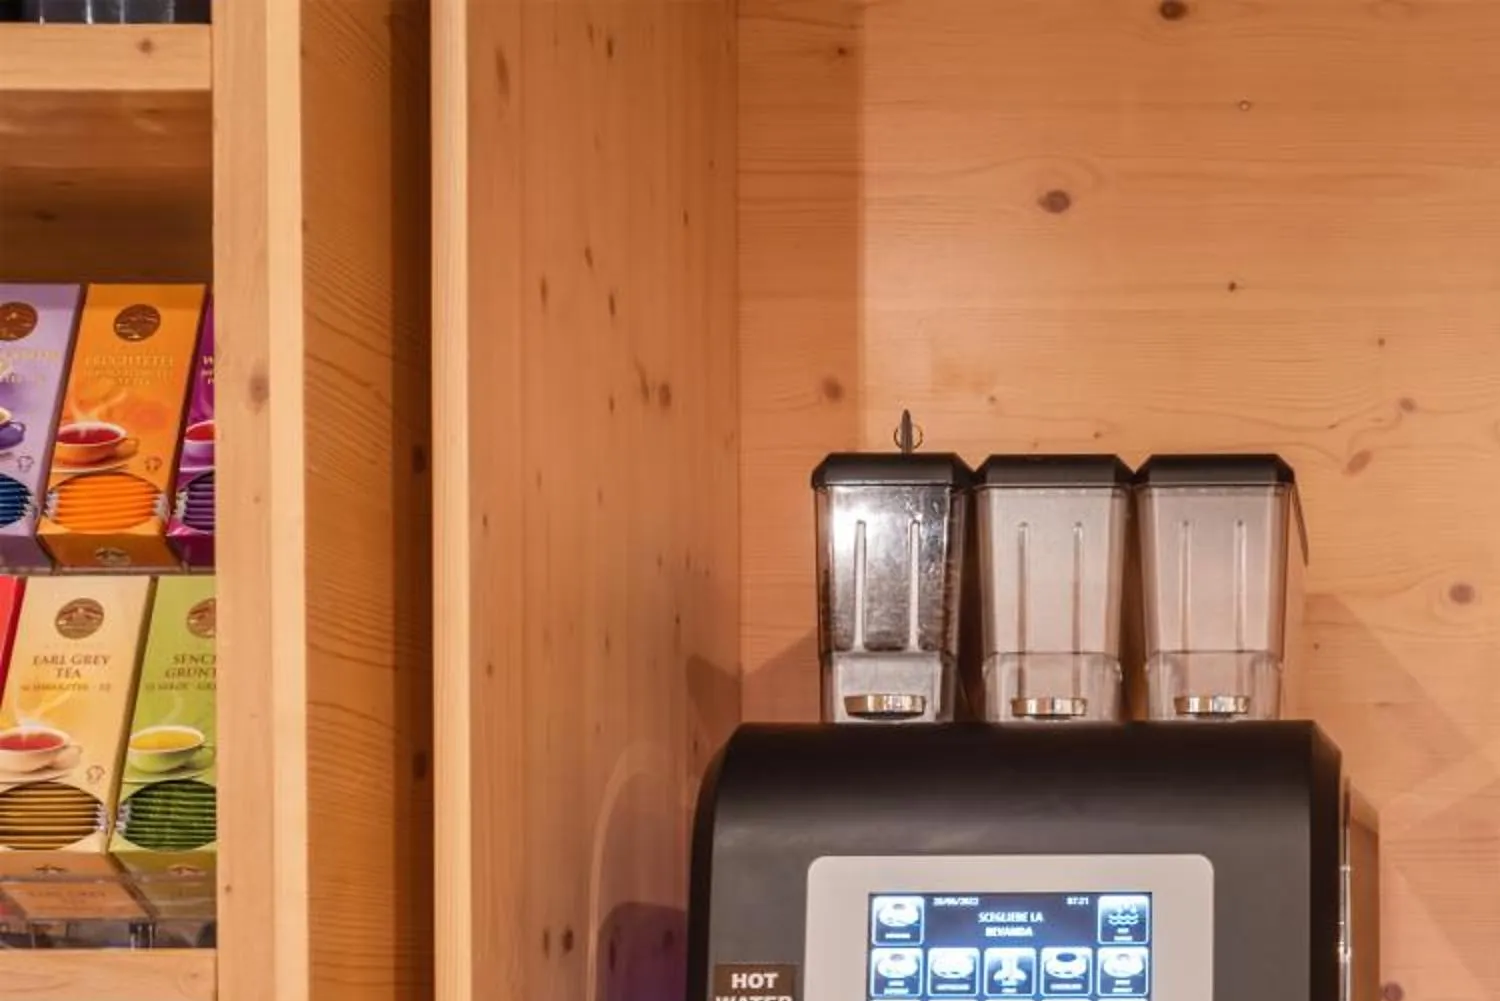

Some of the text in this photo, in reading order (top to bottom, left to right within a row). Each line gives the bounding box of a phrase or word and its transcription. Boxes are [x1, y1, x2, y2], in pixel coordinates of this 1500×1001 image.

[32, 653, 112, 666] EARL GREY
[55, 667, 82, 679] TEA
[1030, 911, 1044, 923] LA
[731, 973, 779, 989] HOT
